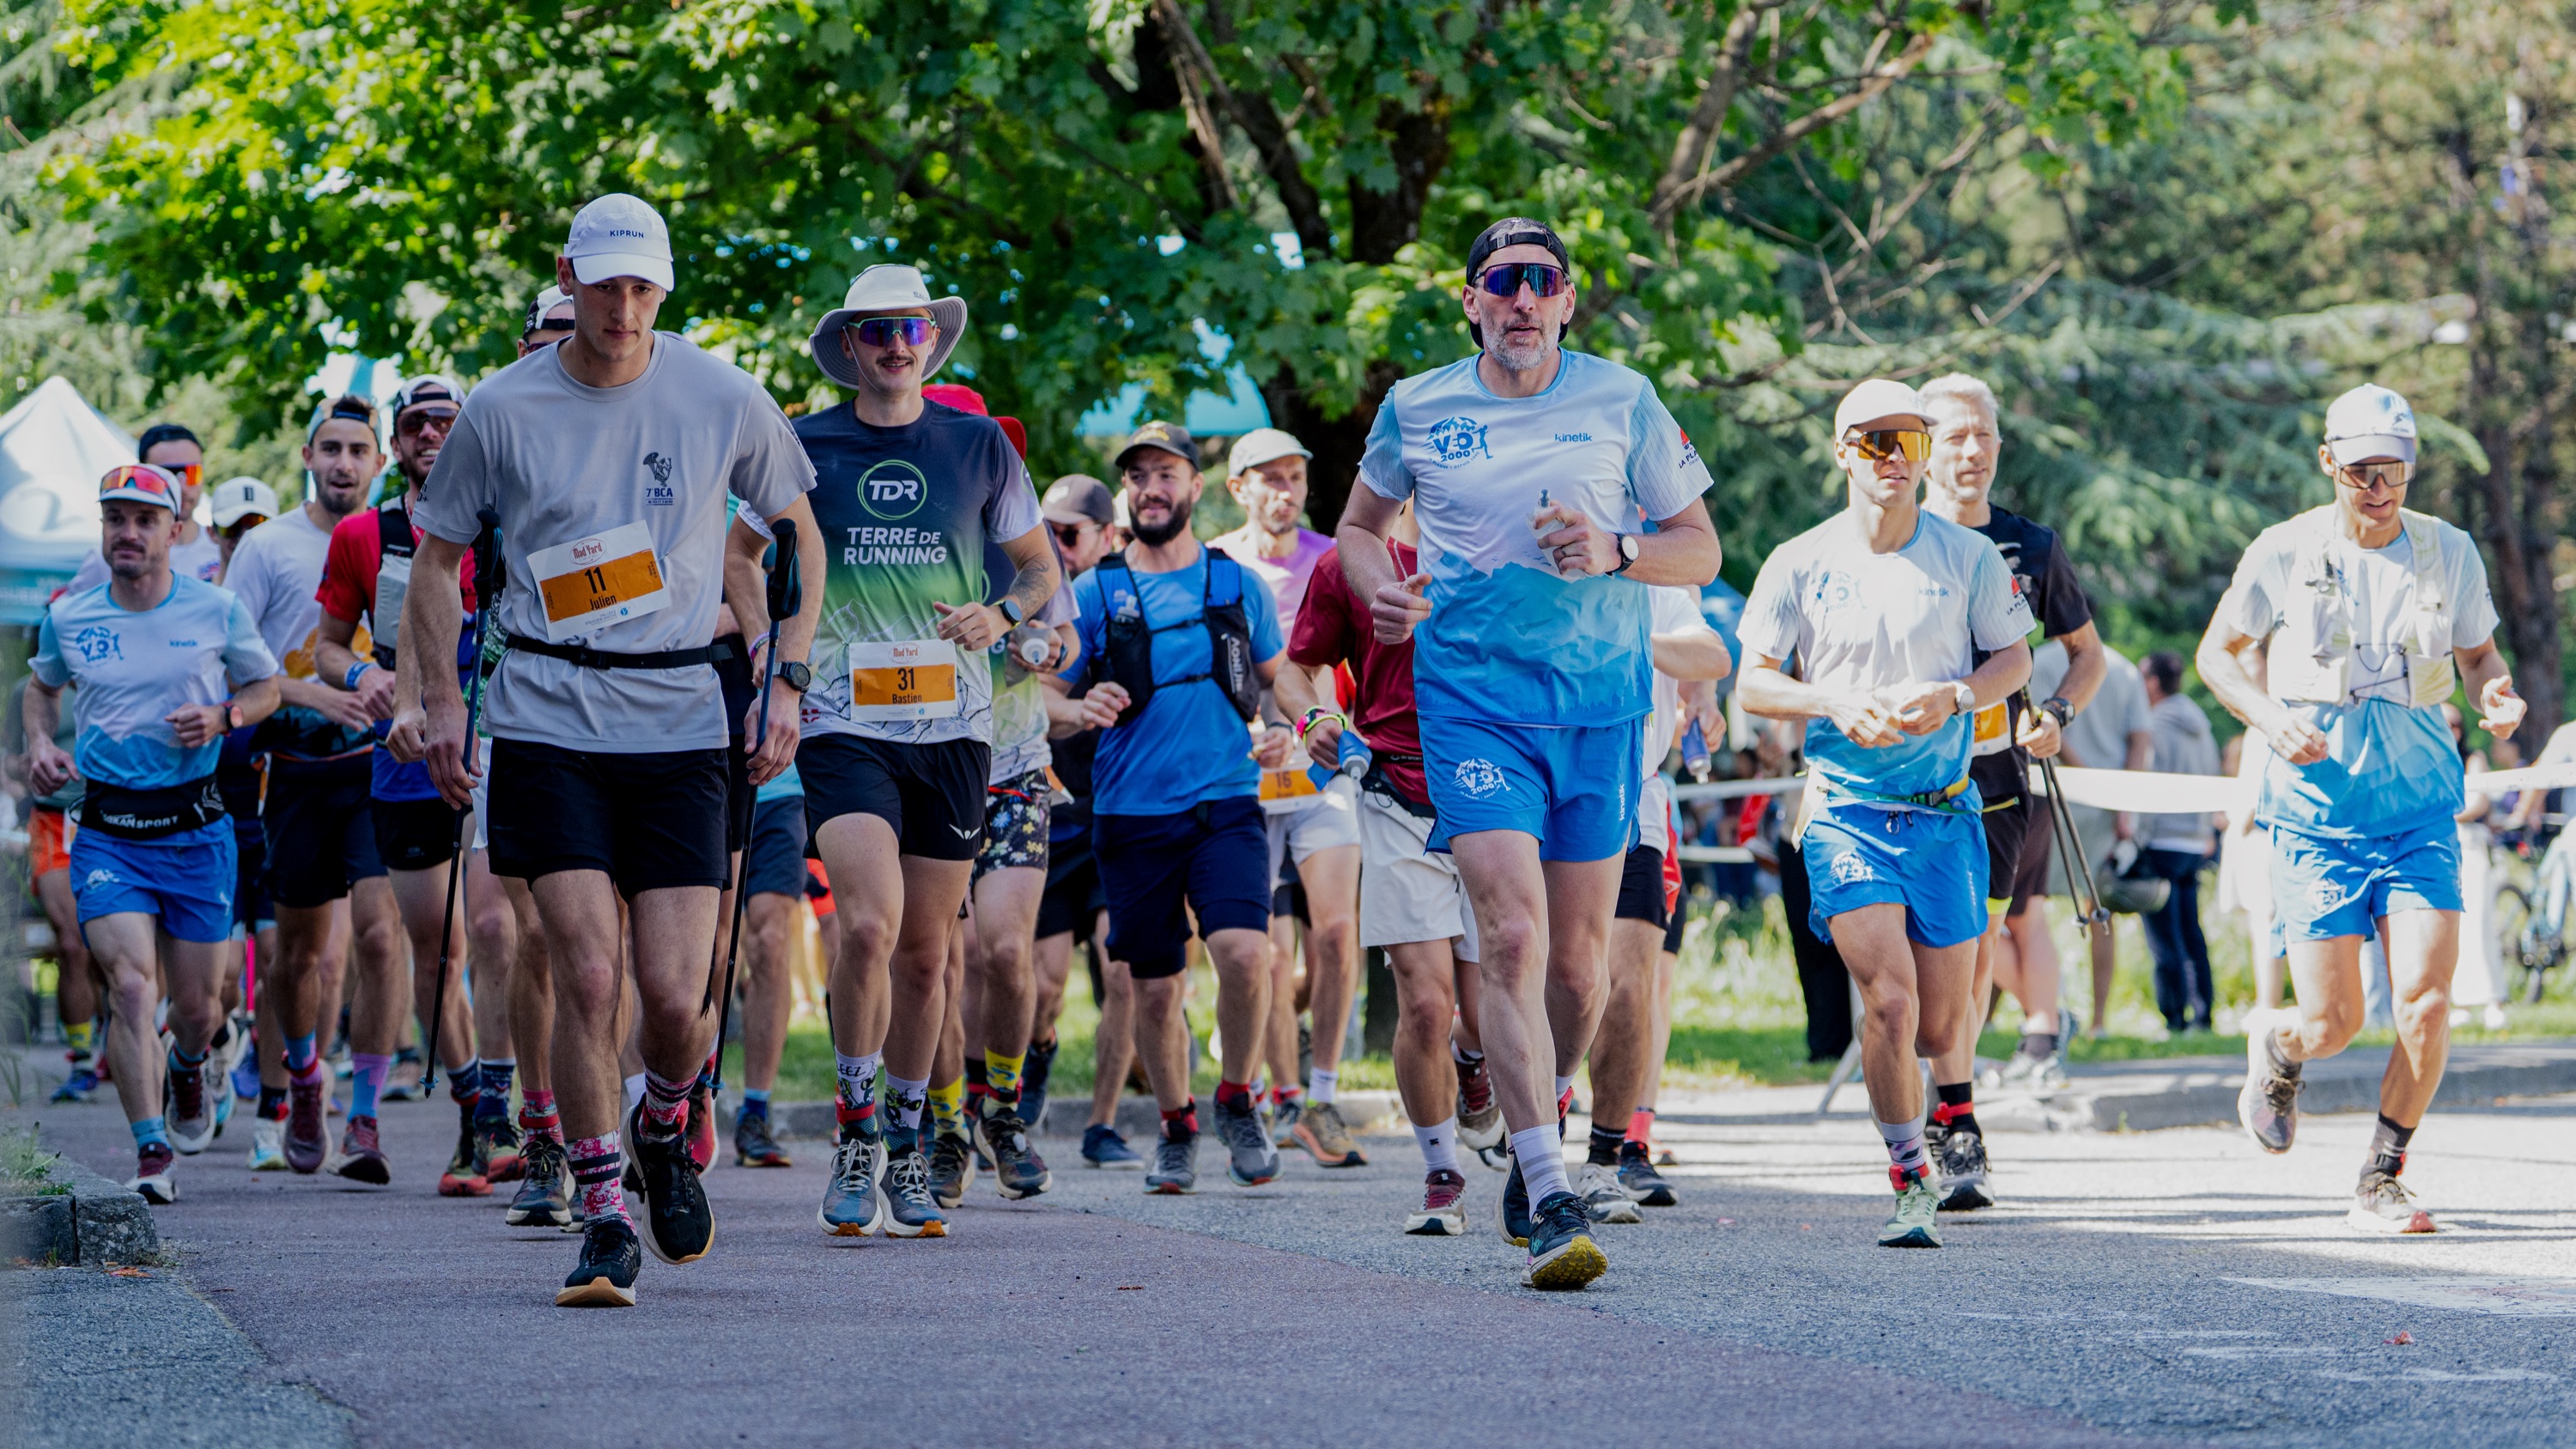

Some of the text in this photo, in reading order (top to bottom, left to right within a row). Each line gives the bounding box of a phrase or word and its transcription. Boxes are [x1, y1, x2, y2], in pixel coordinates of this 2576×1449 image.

[610, 230, 644, 239] KIPRUN
[1555, 433, 1592, 442] kinetik
[1441, 450, 1470, 463] 2000
[1679, 459, 1686, 469] LA
[869, 480, 918, 501] TDR
[847, 527, 941, 545] TERRE DE
[573, 542, 603, 559] Mad Yard
[843, 546, 947, 565] RUNNING
[584, 567, 606, 594] 11
[590, 595, 617, 610] Julien
[893, 647, 918, 658] Mad Yard
[897, 667, 914, 691] 31
[892, 694, 922, 704] Bastien
[1471, 783, 1494, 795] 2000
